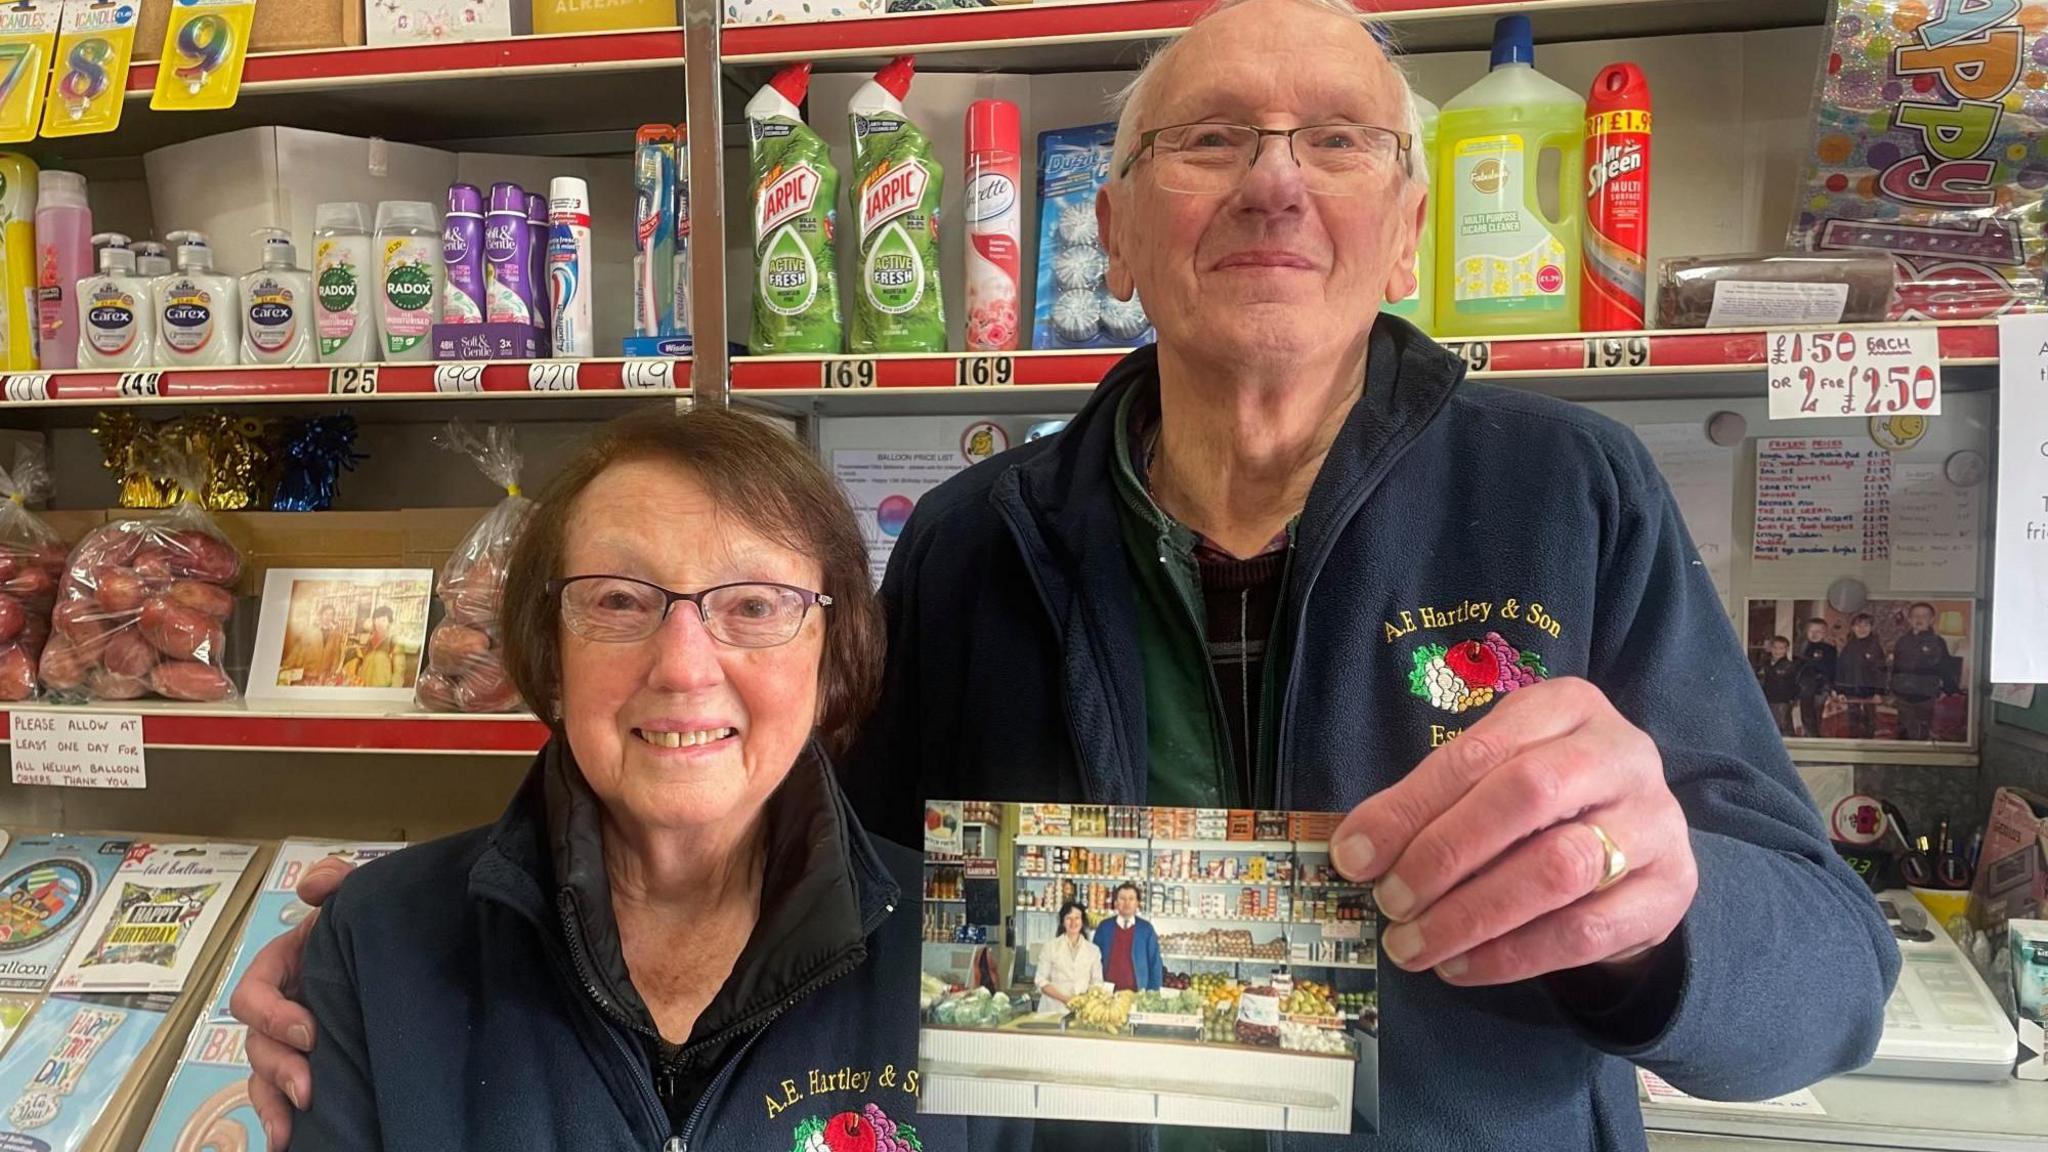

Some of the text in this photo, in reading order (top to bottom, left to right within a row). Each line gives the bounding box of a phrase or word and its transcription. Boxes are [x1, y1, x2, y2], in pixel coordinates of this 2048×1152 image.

[1611, 182, 1641, 192] MULTI
[1463, 211, 1520, 225] MULTI PURPOSE
[499, 225, 513, 241] &
[1489, 221, 1521, 232] CLEANER
[769, 257, 805, 273] ACTIVE
[875, 255, 912, 270] ACTIVE
[769, 273, 806, 288] FRESH
[874, 270, 913, 285] FRESH
[320, 285, 355, 296] RADOX
[387, 283, 431, 295] RADOX
[90, 309, 130, 323] Carex
[166, 307, 206, 321] Carex
[251, 306, 290, 320] Carex
[556, 304, 565, 352] Aquafresh
[461, 333, 511, 348] Soft & 3x
[463, 345, 492, 357] Gentle
[1586, 337, 1648, 368] 199
[1770, 332, 1912, 365] £1.50 EACH
[823, 360, 874, 388] 169
[958, 357, 1012, 386] 169
[331, 367, 376, 394] 125
[1771, 364, 1936, 414] OR 2 FOR £2.50
[1419, 600, 1493, 629] Hartley
[1501, 598, 1520, 619] &
[1526, 602, 1562, 639] Son
[15, 716, 137, 731] PLEASE ALLOW AT
[16, 740, 48, 751] LEAST
[58, 742, 79, 752] ONE
[87, 742, 109, 753] DAY
[16, 761, 140, 774] ALL HELIUM BALLOON
[63, 775, 97, 786] THANK
[106, 777, 129, 787] YOU
[133, 905, 181, 923] HAPPY
[110, 925, 180, 944] BIRTHDAY
[0, 961, 48, 976] alloon
[765, 1079, 804, 1119] A.E.
[808, 1067, 871, 1097] Hartley
[879, 1064, 897, 1087] &
